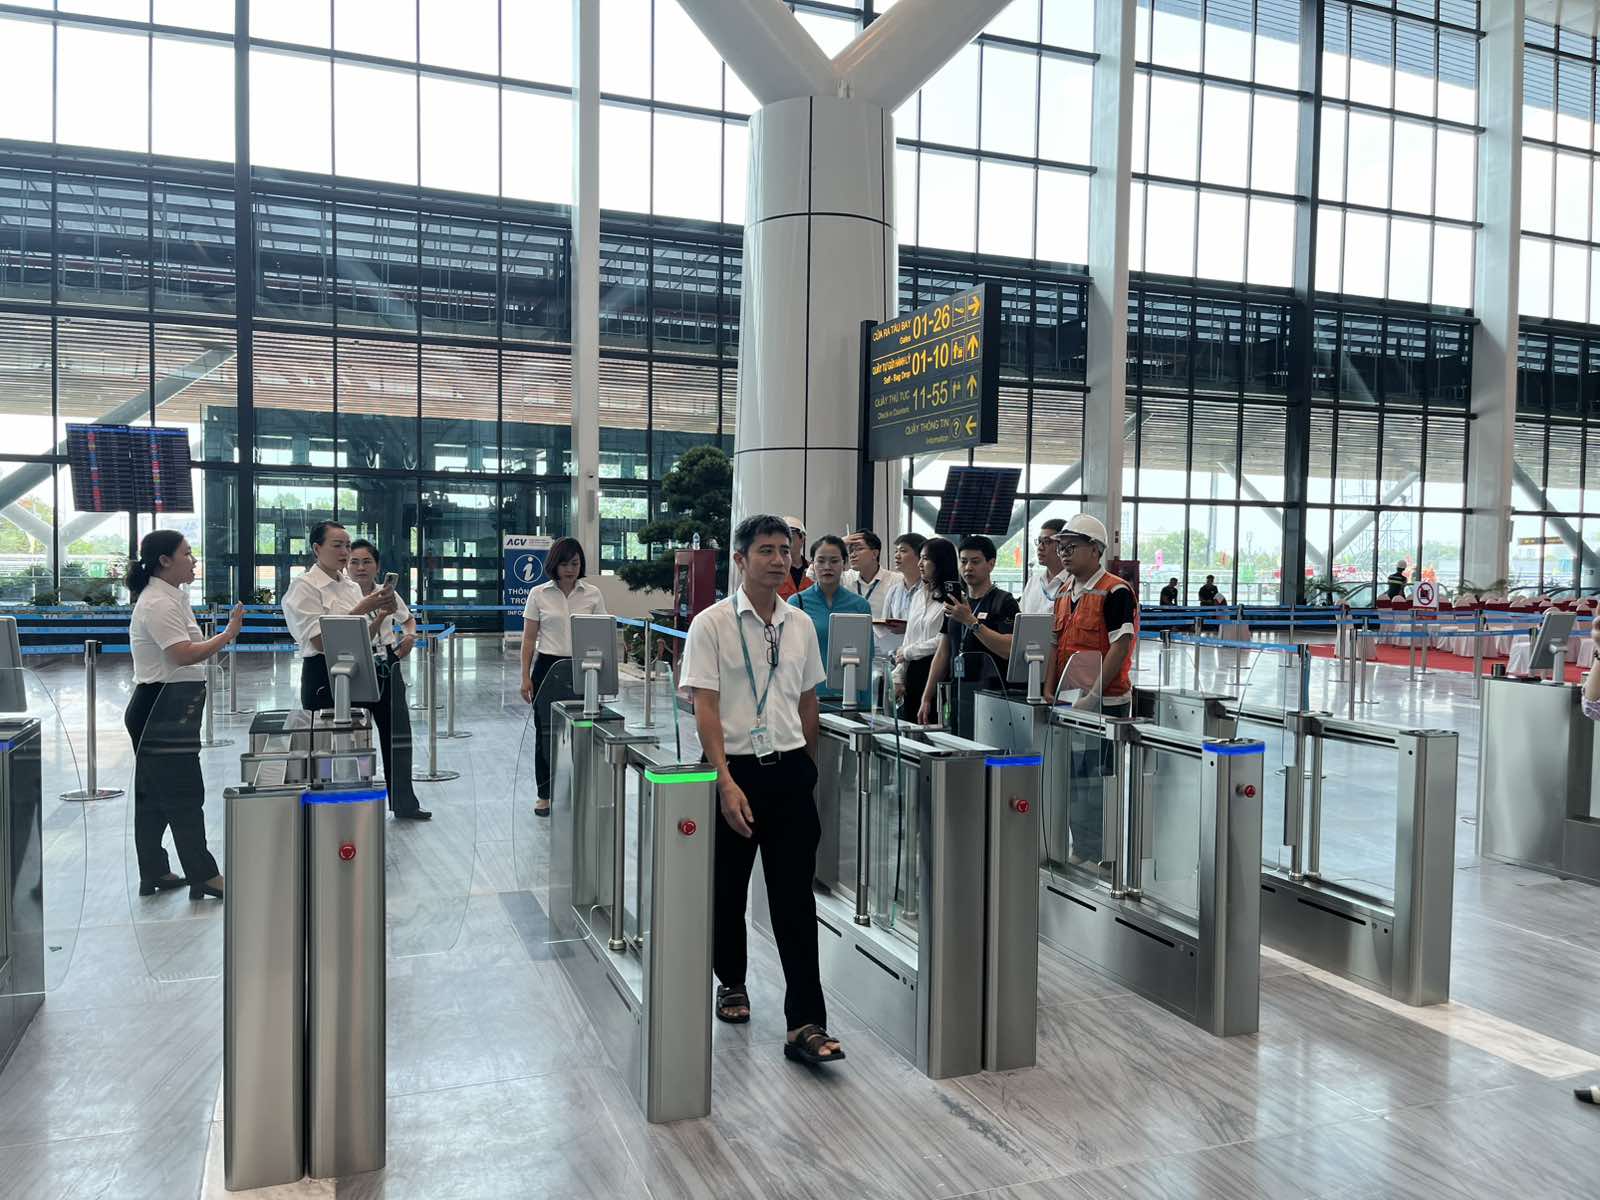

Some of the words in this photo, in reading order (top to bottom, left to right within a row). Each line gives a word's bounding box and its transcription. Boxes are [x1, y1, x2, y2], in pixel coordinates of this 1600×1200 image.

[913, 304, 950, 339] 01-26
[912, 342, 948, 376] 01-10
[913, 380, 948, 410] 11-55
